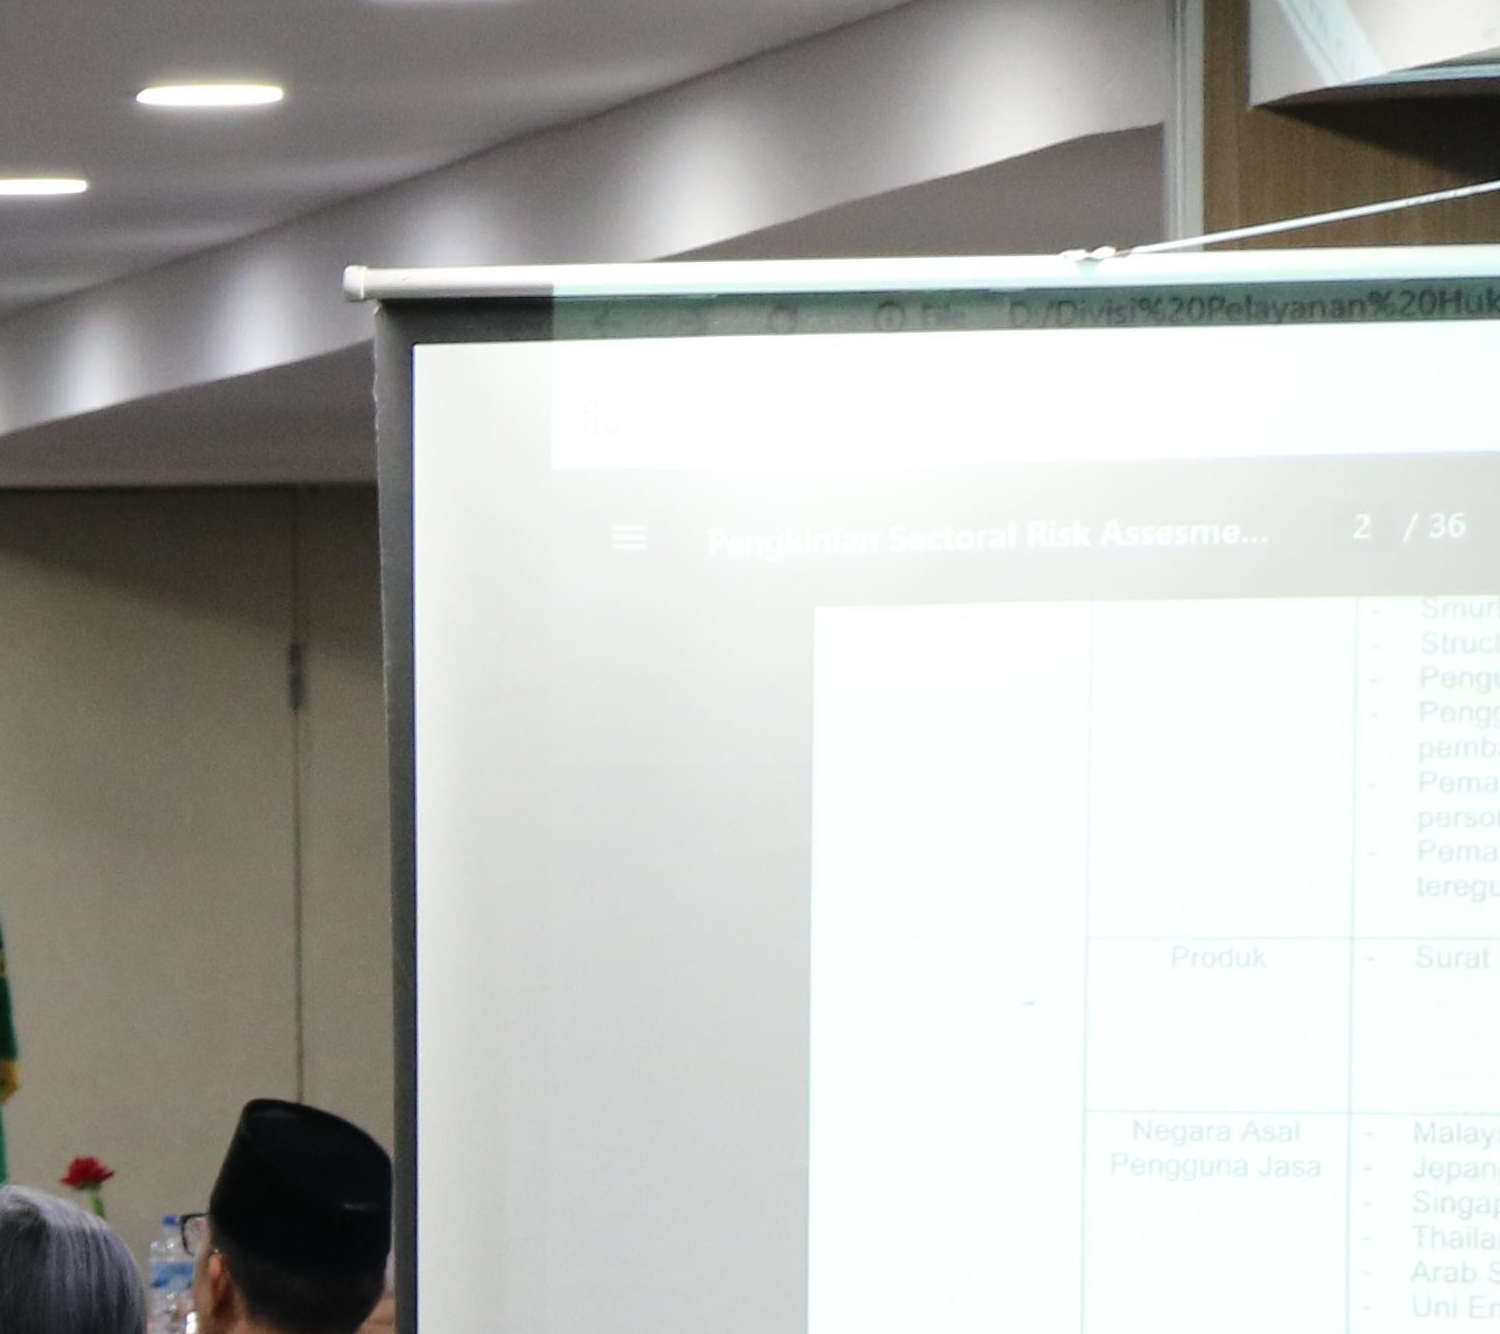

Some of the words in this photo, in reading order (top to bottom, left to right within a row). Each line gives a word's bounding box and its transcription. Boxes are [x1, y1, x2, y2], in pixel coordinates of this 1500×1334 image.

[707, 525, 880, 561] Pengkinian
[888, 521, 1016, 554] Sectoral
[1026, 520, 1091, 548] Risk
[1100, 517, 1268, 547] Assesme...
[1352, 514, 1370, 540] 2
[1429, 511, 1466, 538] 36
[1171, 945, 1267, 969] Produk
[1415, 944, 1490, 969] Surat
[1132, 1120, 1232, 1147] Negara
[1241, 1119, 1301, 1143] Asal
[1413, 1121, 1500, 1149] Malay
[1111, 1153, 1249, 1182] Pengguna
[1258, 1154, 1321, 1177] Jasa
[1412, 1156, 1500, 1185] Jepan
[1412, 1225, 1500, 1250] Thaila
[1410, 1260, 1477, 1284] Arab
[1411, 1295, 1456, 1318] Uni
